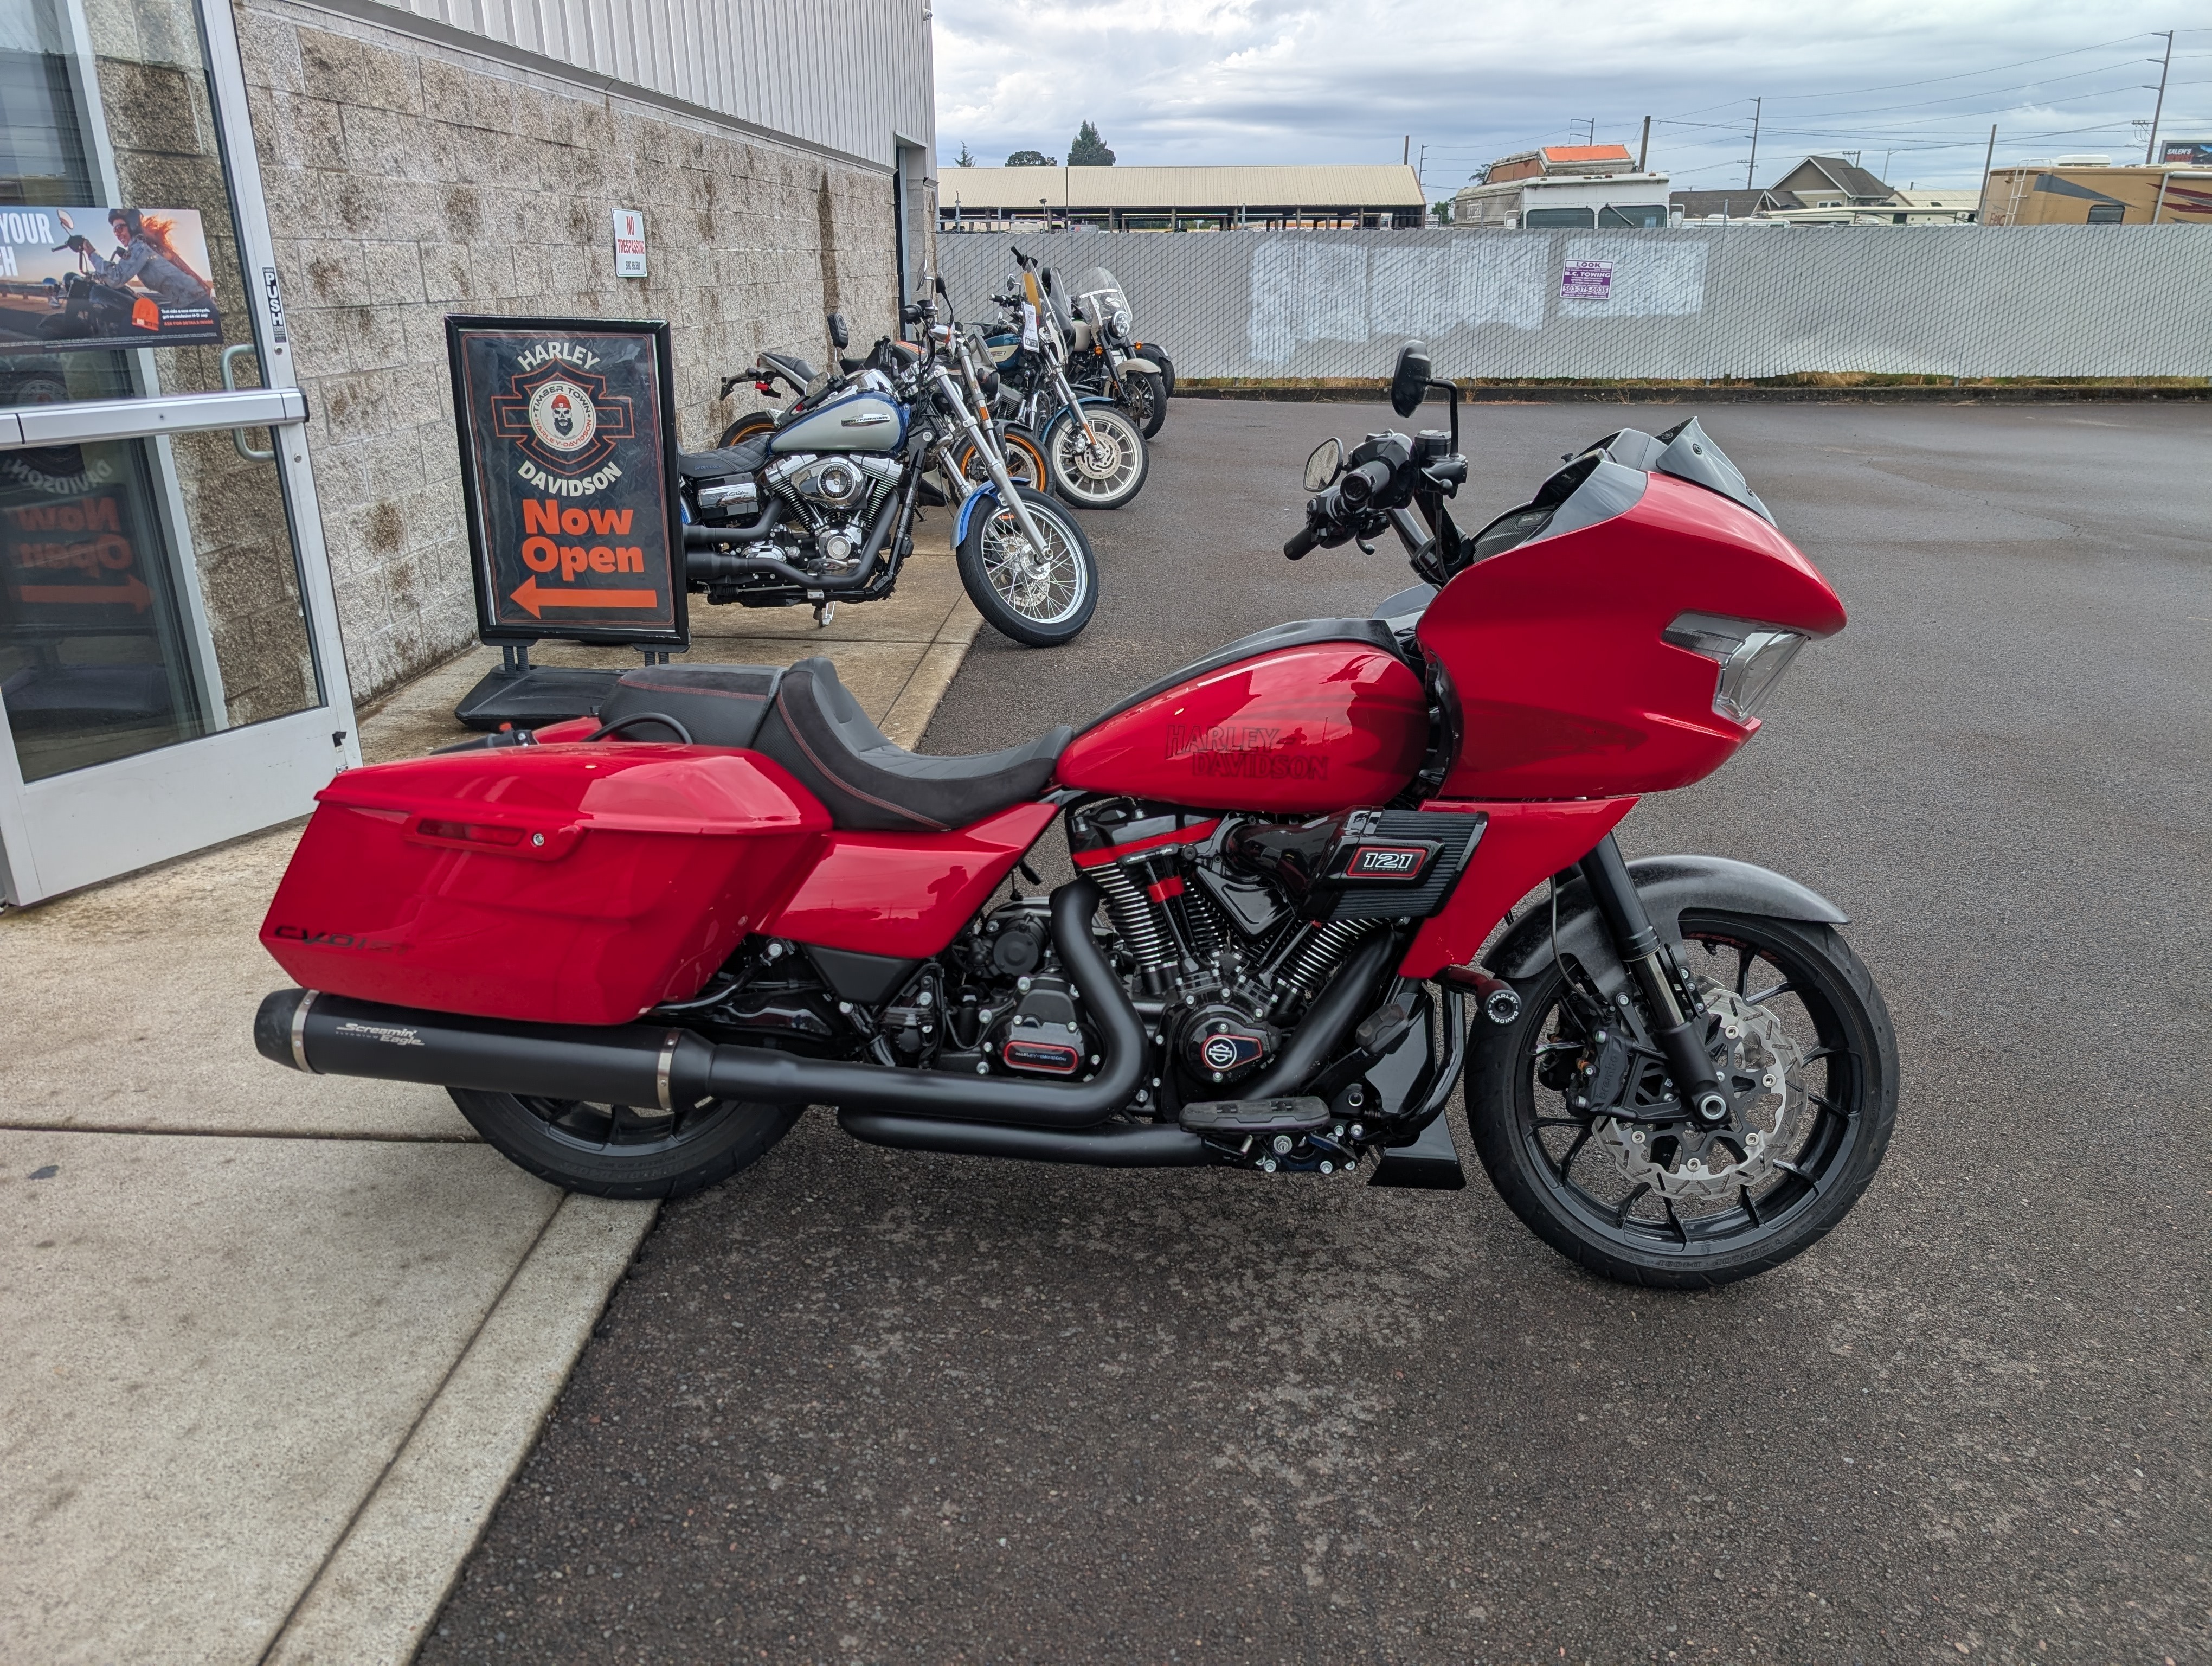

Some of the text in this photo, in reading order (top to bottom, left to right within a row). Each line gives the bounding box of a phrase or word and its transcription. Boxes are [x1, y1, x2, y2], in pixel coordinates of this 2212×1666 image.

[0, 213, 54, 244] YOUR
[626, 216, 635, 235] NO
[617, 239, 645, 254] TRESPASSING
[265, 272, 283, 325] PUSH
[517, 342, 600, 373] HARLEY
[533, 386, 591, 413] TIMBER TOWN
[535, 419, 591, 447] HARLEY-DAVIDSON
[518, 460, 622, 497] DAVIDSON
[522, 499, 633, 535] Now
[521, 536, 645, 581] Open
[1192, 752, 1328, 780] DAVIDSON
[1364, 853, 1413, 869] 121
[1490, 994, 1518, 1004] HARLEY
[1487, 1010, 1519, 1024] DAVIDSON
[380, 1034, 425, 1046] Eagle
[1595, 1055, 1619, 1100] brembo
[1712, 1244, 1770, 1267] DUNLOP
